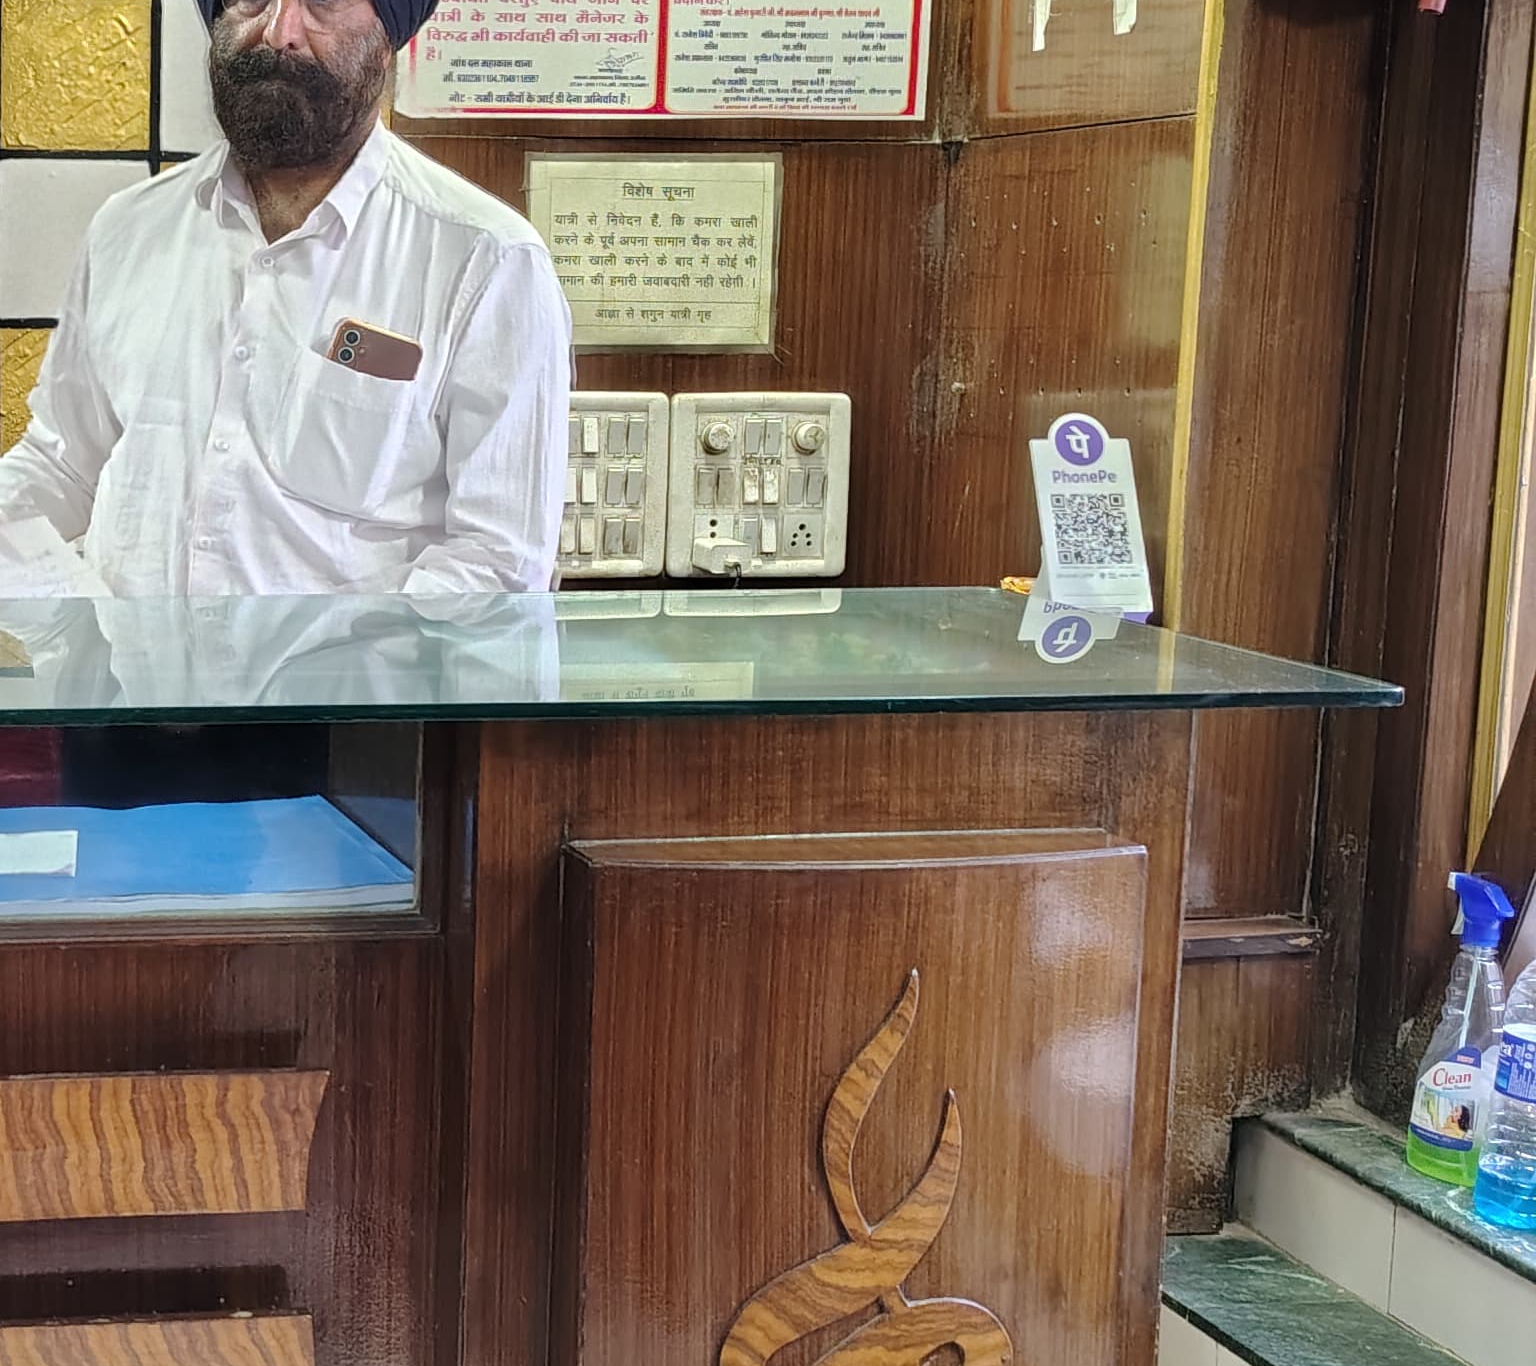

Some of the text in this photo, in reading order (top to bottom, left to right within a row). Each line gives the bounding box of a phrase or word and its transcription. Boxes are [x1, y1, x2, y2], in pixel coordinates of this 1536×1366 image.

[470, 9, 649, 24] के साथ साथ मैनेजर के
[471, 27, 489, 42] भी
[494, 27, 555, 43] कार्यवाही
[559, 28, 579, 43] की
[581, 32, 601, 43] जा
[603, 29, 648, 44] सकती
[622, 182, 695, 201] विशेष सूचना
[554, 212, 758, 229] यात्री से निवेदन कि कमरा खाली
[553, 232, 578, 245] करने
[584, 232, 594, 245] के
[600, 231, 614, 249] पूर्व
[619, 235, 648, 247] अपना
[653, 236, 686, 247] सामान
[716, 236, 733, 248] कर
[552, 255, 581, 266] कमरा
[588, 252, 617, 266] खाली
[624, 253, 649, 267] करने
[656, 253, 667, 267] के
[675, 256, 694, 267] बाद
[717, 255, 738, 268] कोई
[745, 255, 758, 268] भी
[590, 273, 604, 286] की
[610, 274, 637, 287] हमारी
[642, 274, 690, 288] जवाबदारी
[719, 275, 744, 288] रहेगी
[626, 308, 636, 319] से
[670, 307, 691, 320] यात्री
[697, 309, 712, 323] गृह
[1052, 470, 1118, 484] PhonePe
[1433, 1068, 1471, 1087] Clean
